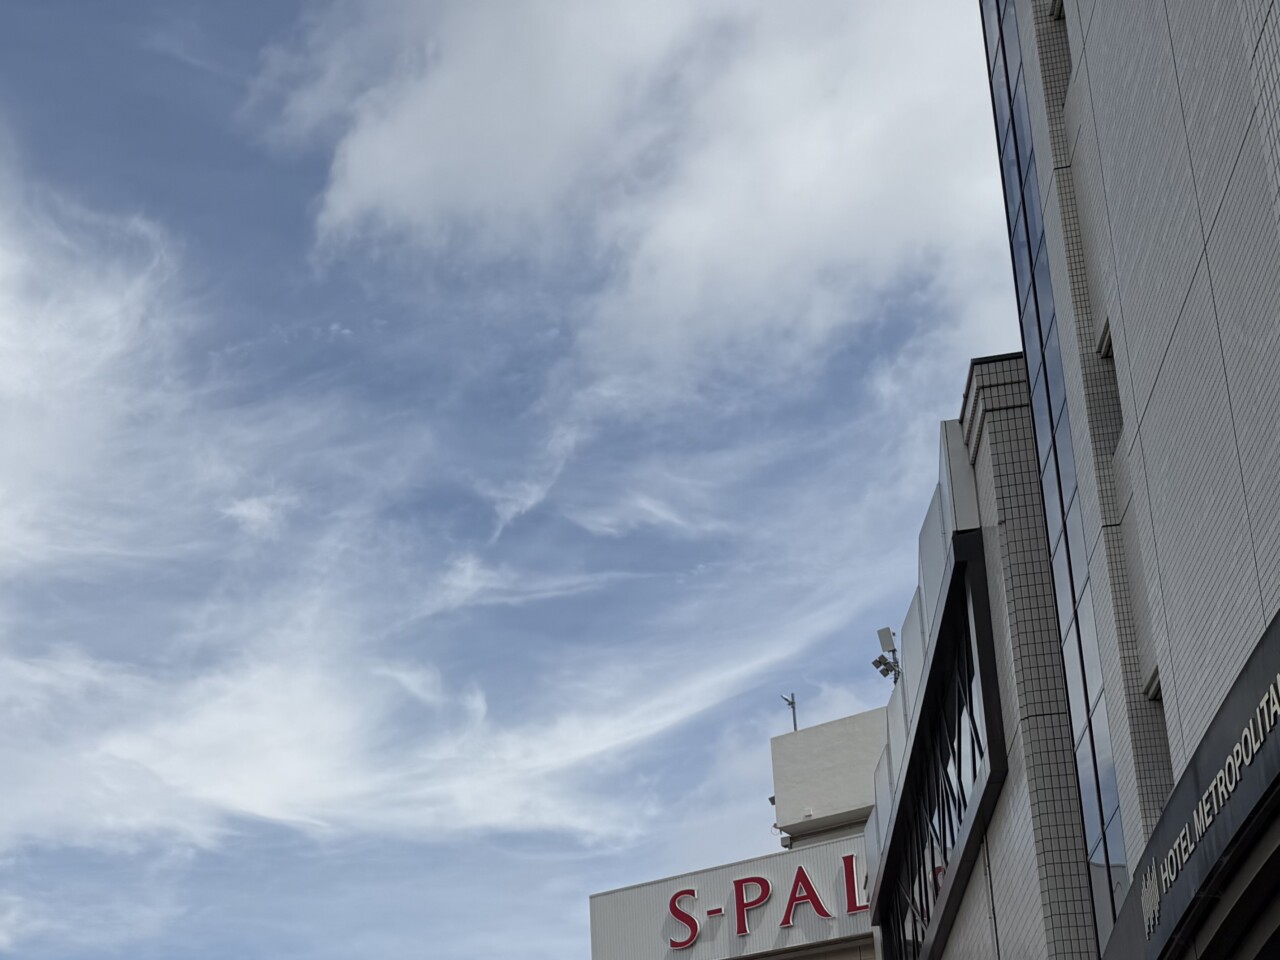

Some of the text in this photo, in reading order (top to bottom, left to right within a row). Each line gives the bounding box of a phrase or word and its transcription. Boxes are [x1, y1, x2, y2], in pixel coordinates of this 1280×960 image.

[1160, 672, 1280, 894] HOTEL METROPOLITA
[669, 854, 870, 950] S-PAL
